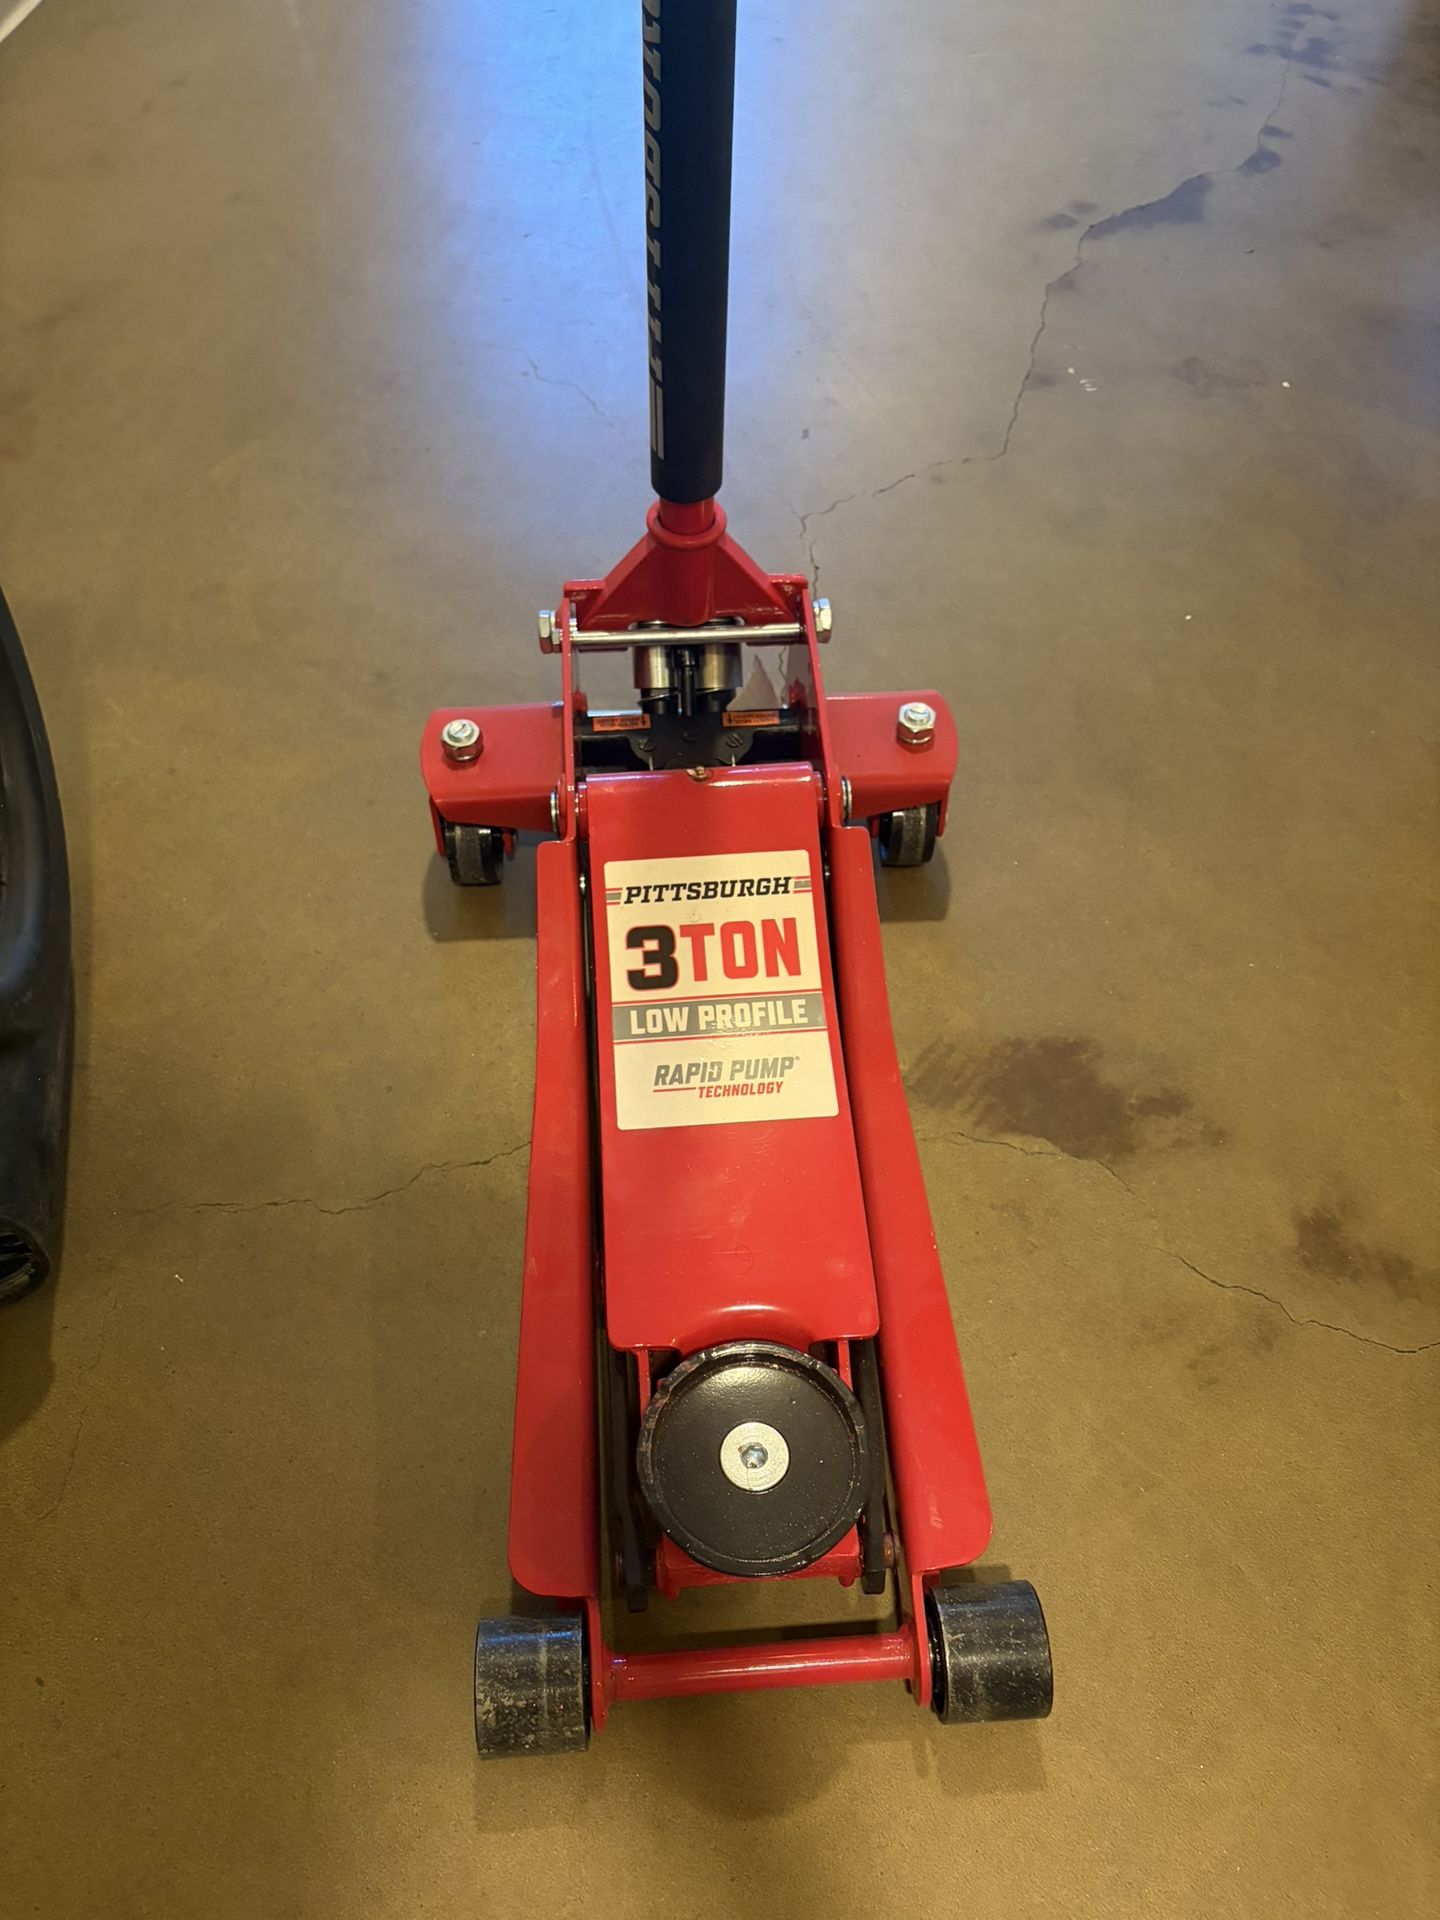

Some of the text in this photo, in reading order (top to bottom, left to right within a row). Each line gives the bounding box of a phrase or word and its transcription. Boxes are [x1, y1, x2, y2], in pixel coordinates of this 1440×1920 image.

[624, 877, 790, 904] PITTSBURGH
[630, 999, 808, 1035] LOW PROFILE
[653, 1061, 723, 1086] RAPID
[698, 1081, 784, 1099] TECHNOLOGY
